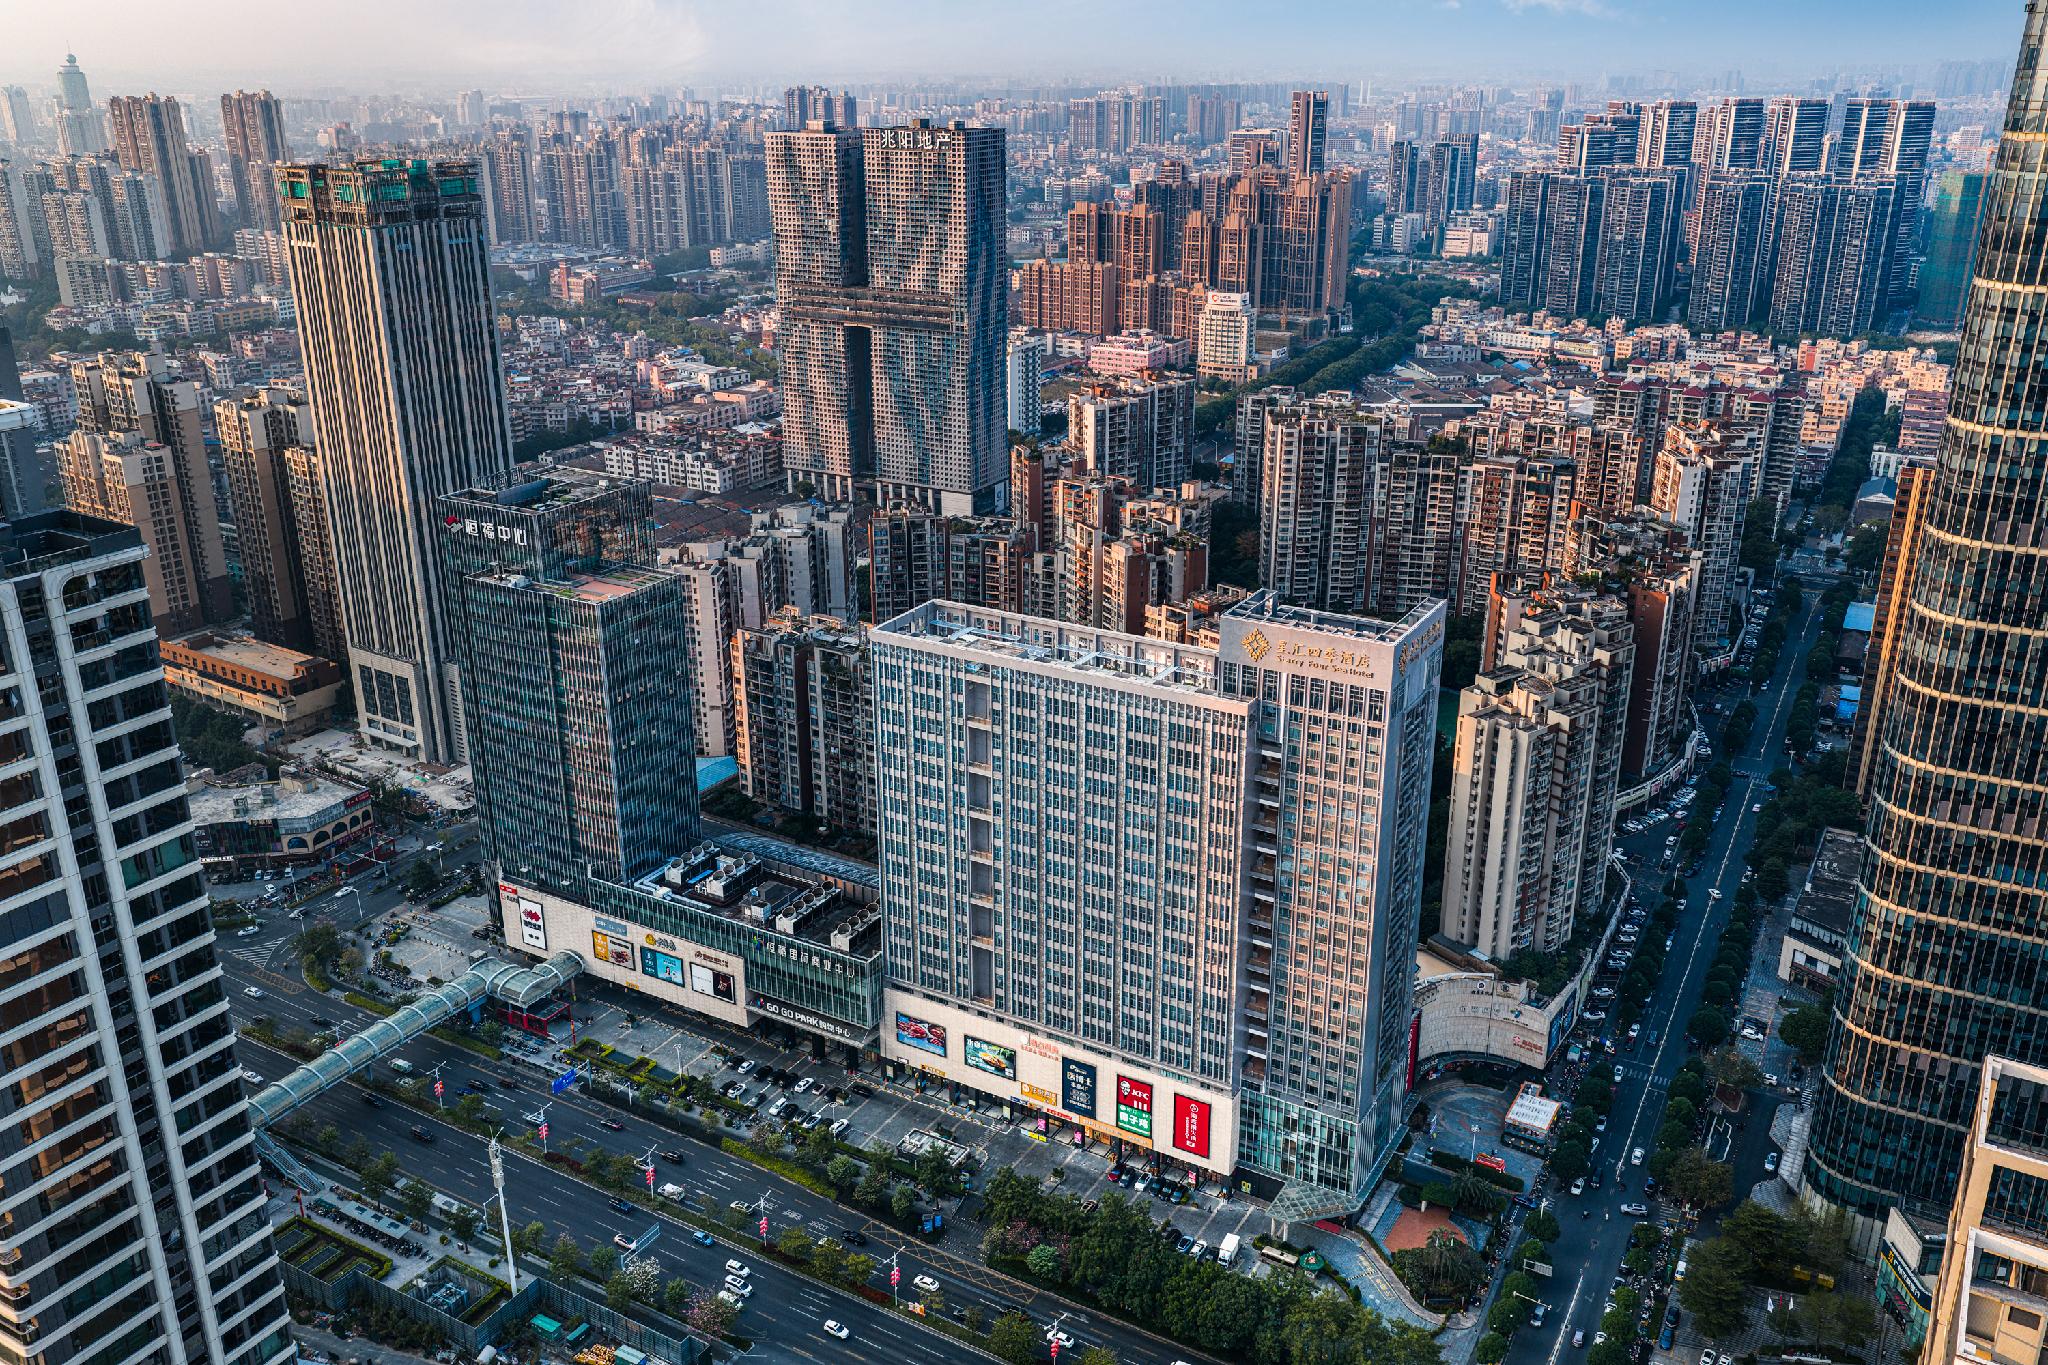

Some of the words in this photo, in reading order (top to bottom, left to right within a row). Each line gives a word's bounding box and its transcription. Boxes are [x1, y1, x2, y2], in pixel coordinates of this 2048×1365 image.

[881, 130, 951, 149] 兆阳地产
[465, 518, 527, 546] 恒福中心
[1276, 639, 1371, 668] 星汇四季酒店
[766, 1002, 779, 1014] GO
[781, 1008, 794, 1019] GO
[795, 1012, 819, 1027] PARK
[1131, 1089, 1150, 1101] KFC
